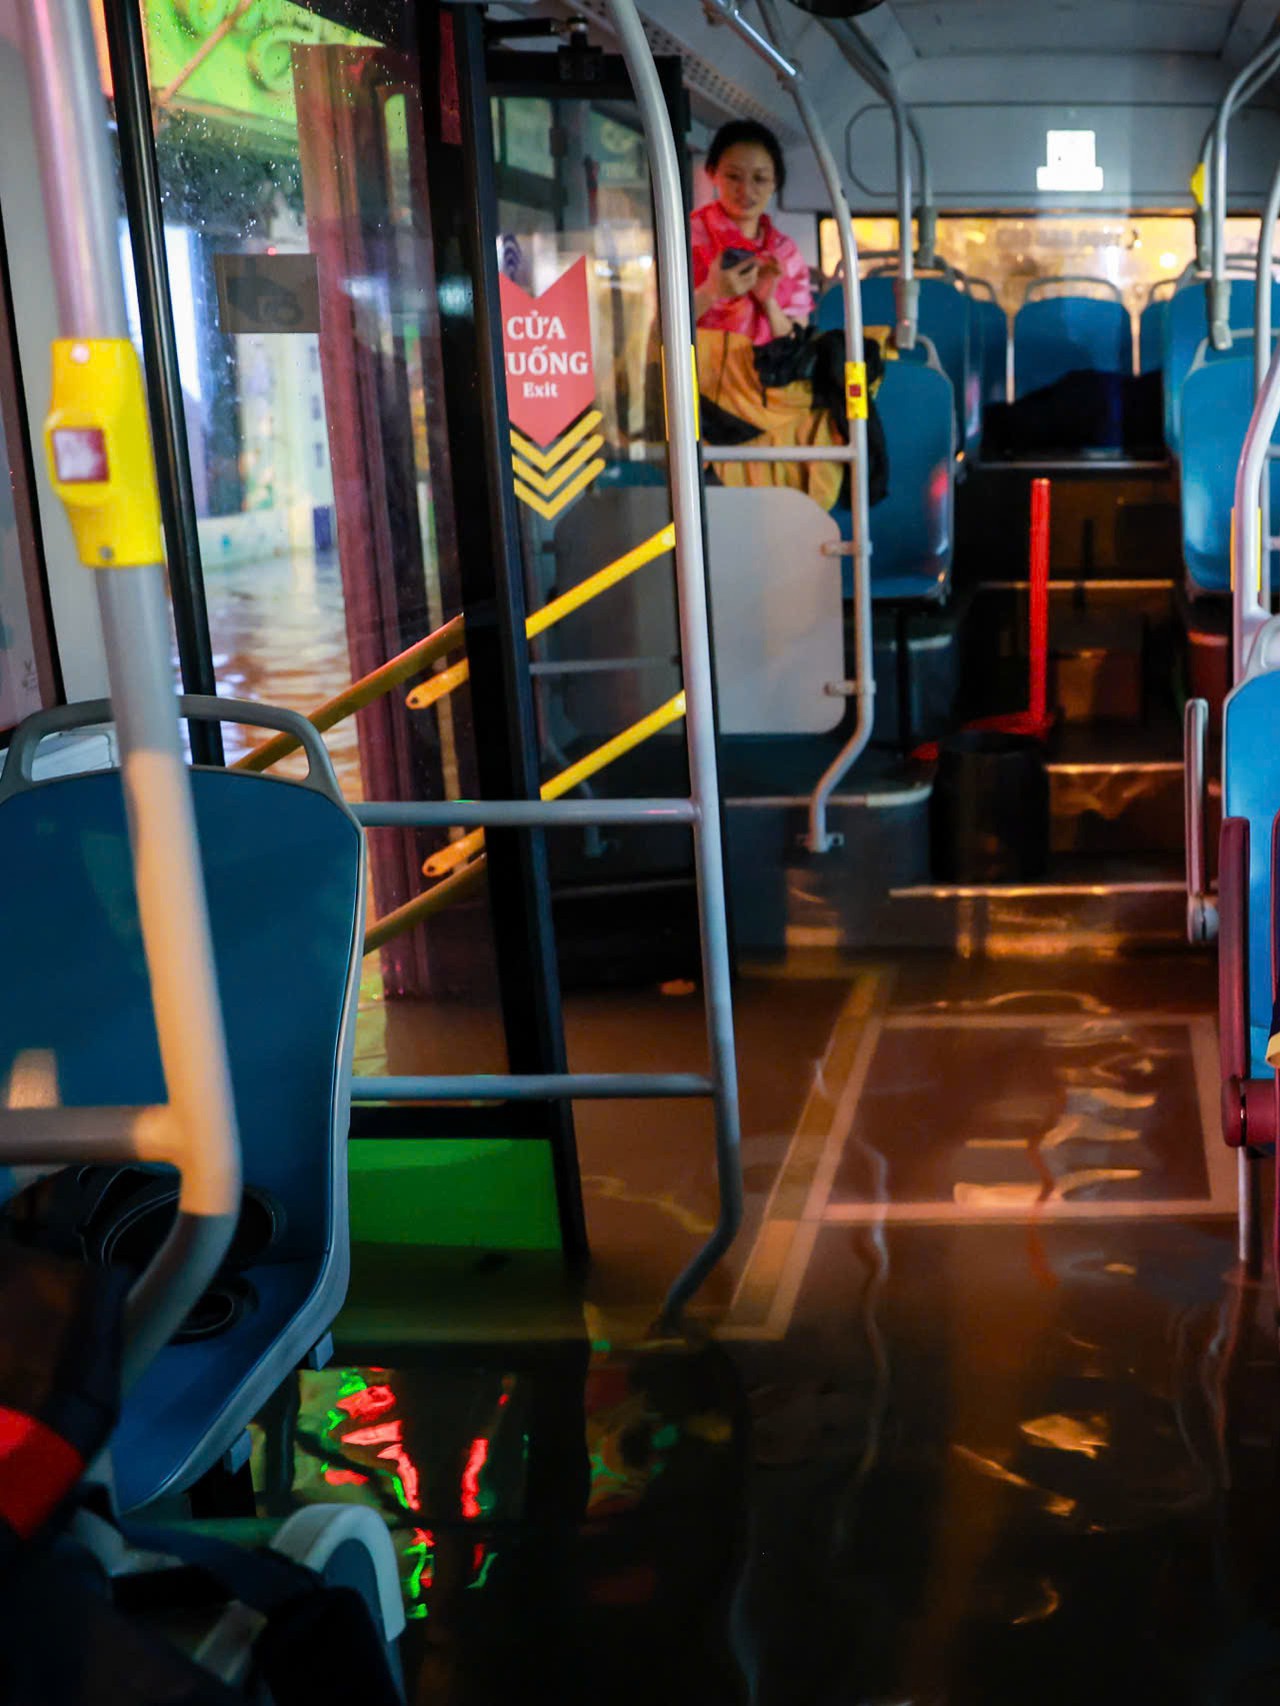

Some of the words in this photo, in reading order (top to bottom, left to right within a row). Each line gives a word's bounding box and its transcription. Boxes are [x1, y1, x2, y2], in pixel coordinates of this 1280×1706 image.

[506, 309, 567, 341] CỬA
[504, 344, 589, 376] UỐNG
[523, 381, 559, 399] Exit
